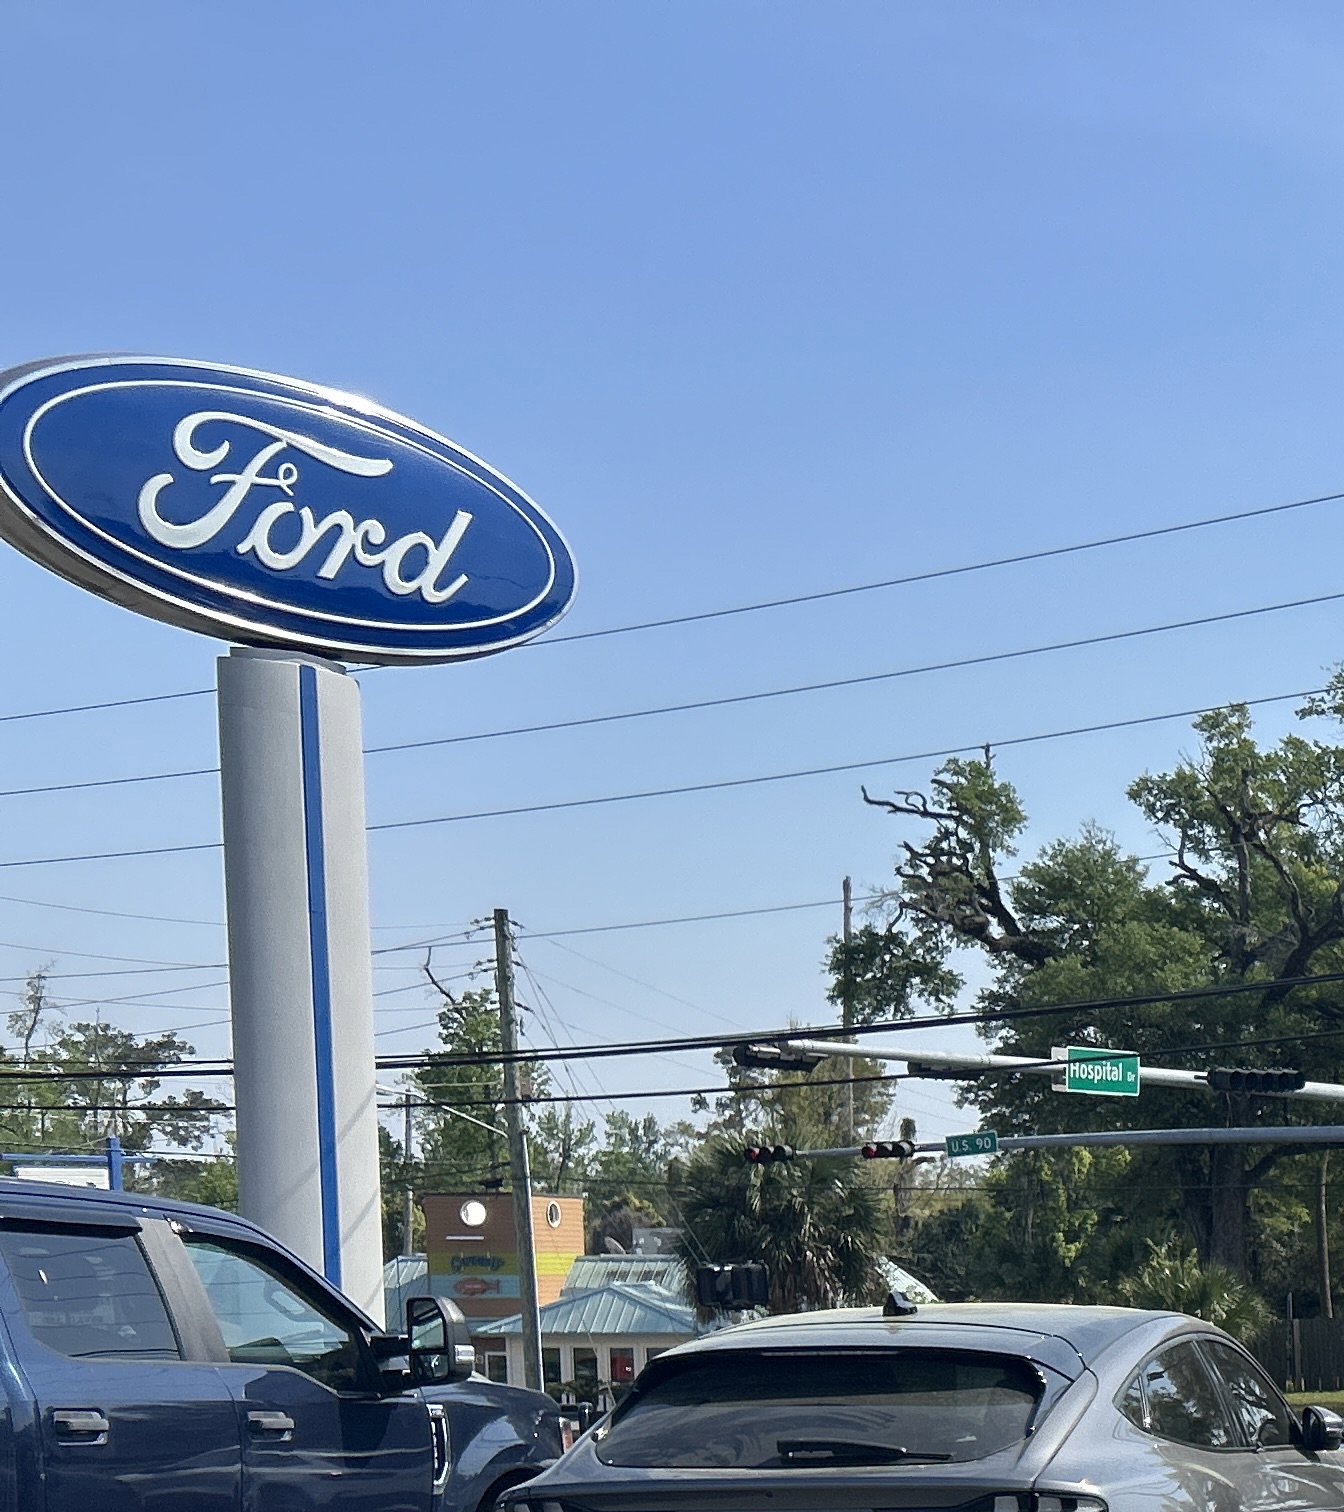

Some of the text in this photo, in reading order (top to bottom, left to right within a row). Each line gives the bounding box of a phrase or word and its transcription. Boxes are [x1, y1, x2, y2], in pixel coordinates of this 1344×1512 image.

[138, 411, 473, 604] Ford
[1069, 1061, 1136, 1083] Hospital Dr
[975, 1136, 992, 1151] 90
